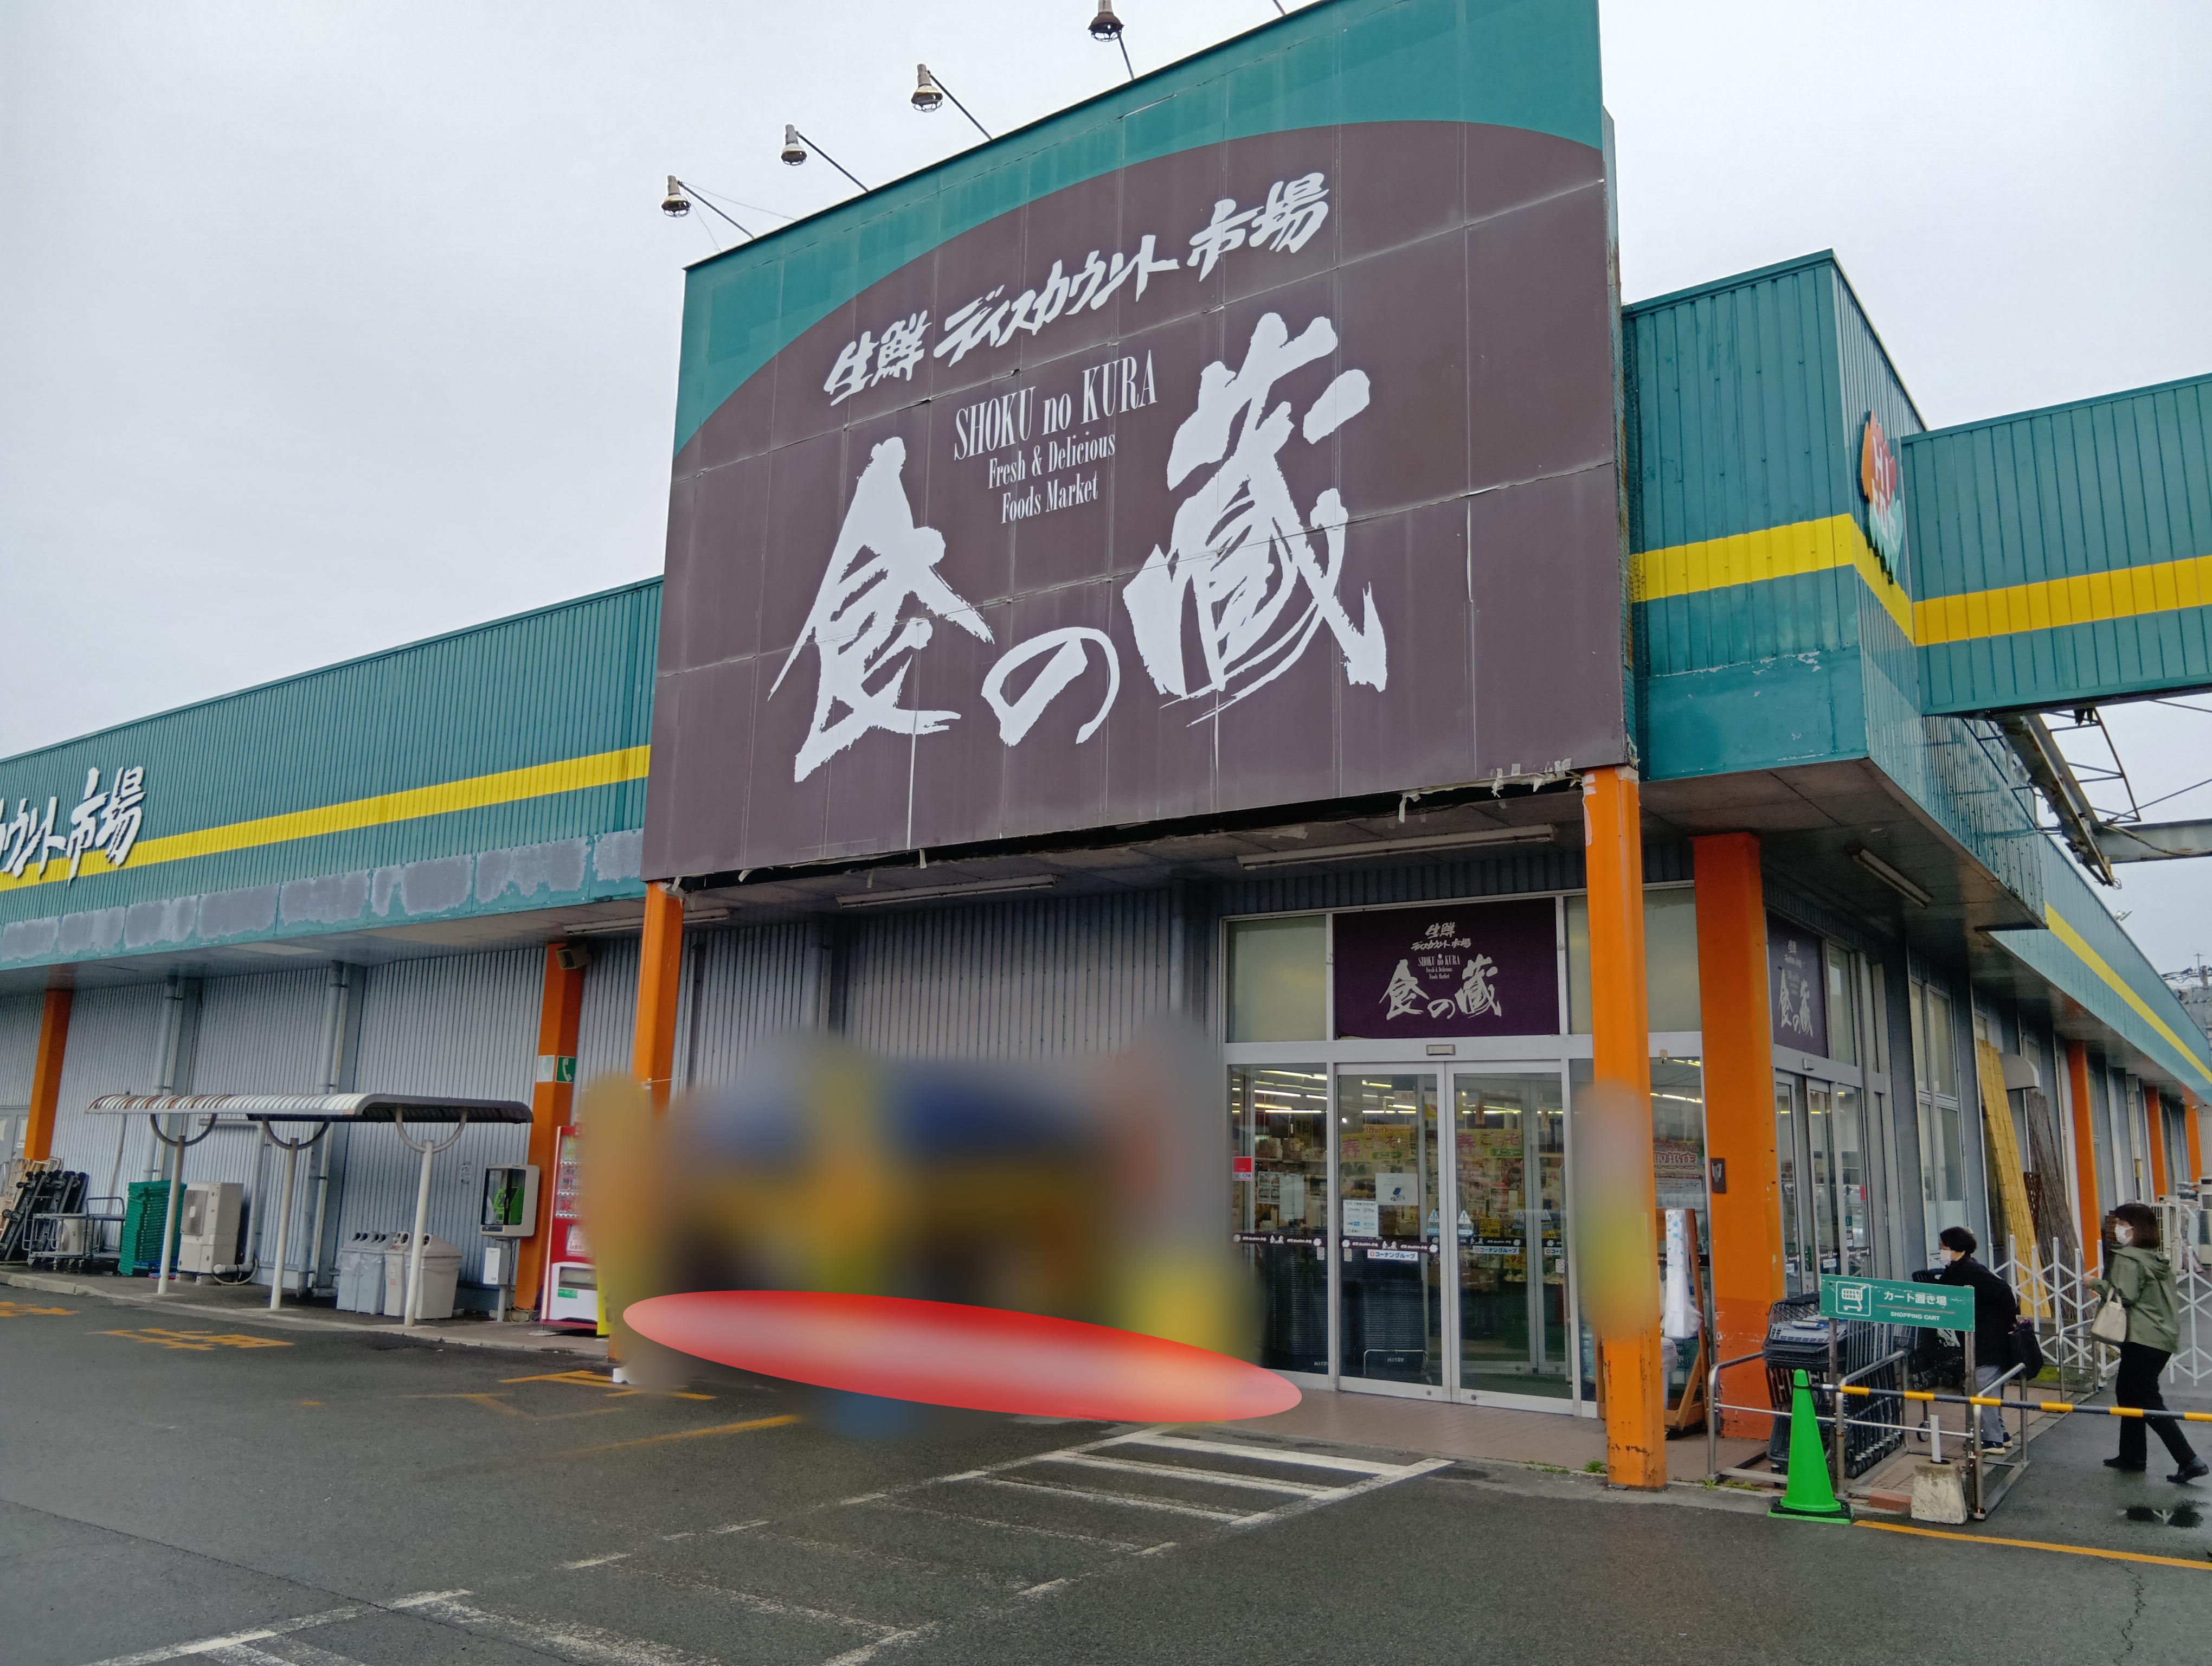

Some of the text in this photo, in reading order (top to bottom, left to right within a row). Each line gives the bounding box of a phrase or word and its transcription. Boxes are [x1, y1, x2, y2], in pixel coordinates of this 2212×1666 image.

[823, 172, 1330, 407] 生鮮 ディスカウント 市場
[954, 349, 1158, 462] SHOKU no KURA
[987, 431, 1116, 490] Fresh & Delicious
[1000, 470, 1099, 524] Foods Market
[767, 312, 1387, 783] 食の蔵
[0, 766, 146, 887] ウント 市場
[1379, 953, 1502, 1021] 食の蔵
[1445, 954, 1460, 965] KURA
[1883, 1291, 1947, 1306] カート置き場
[1890, 1311, 1923, 1319] SHOPPING
